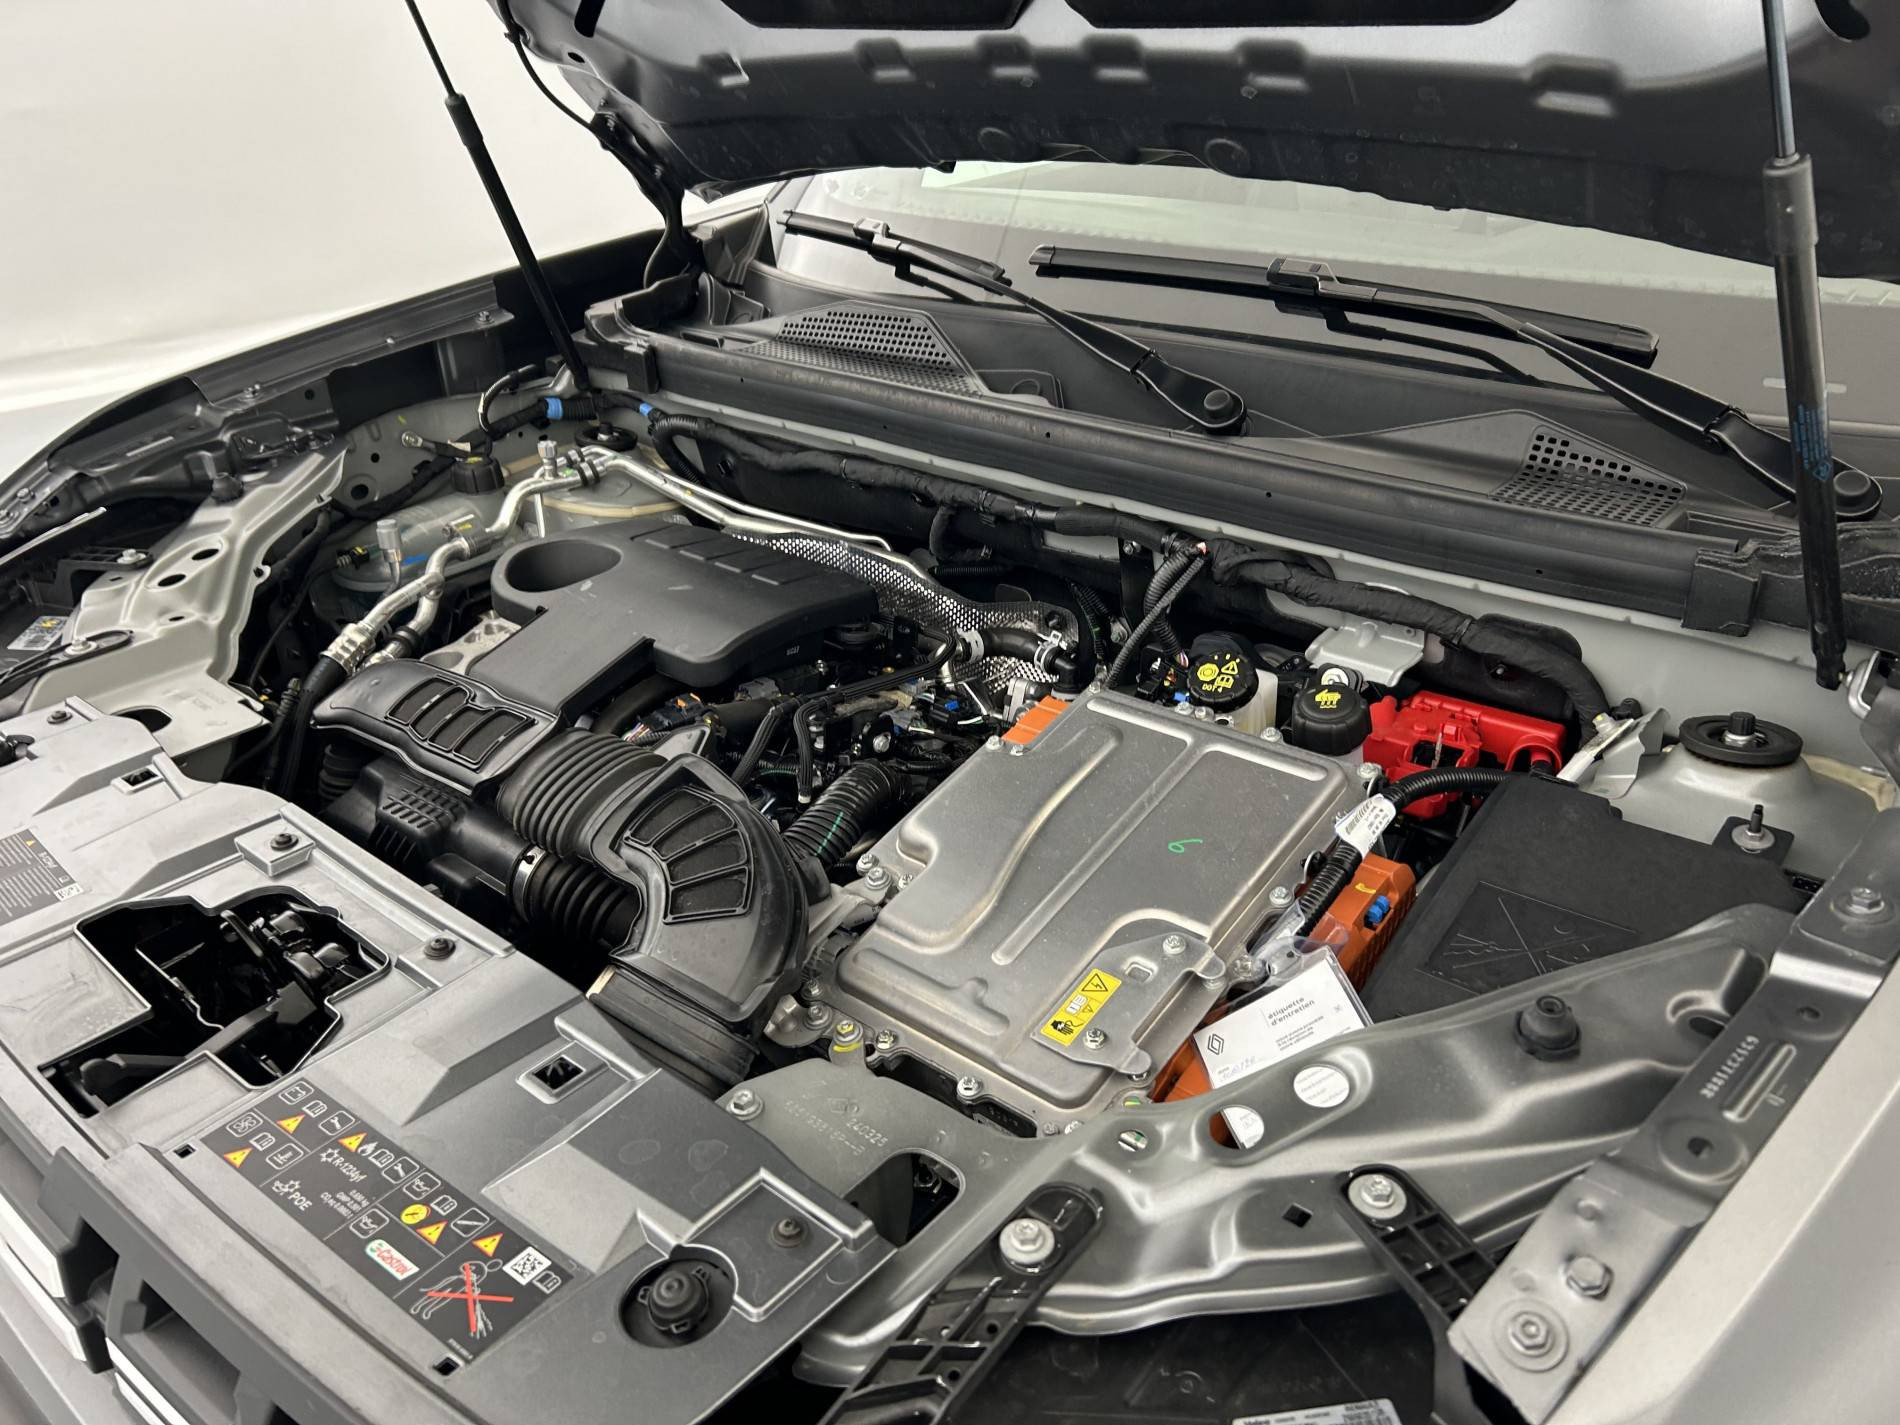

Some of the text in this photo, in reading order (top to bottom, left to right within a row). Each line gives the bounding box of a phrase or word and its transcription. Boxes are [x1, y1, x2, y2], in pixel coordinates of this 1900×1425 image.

[1270, 999, 1315, 1027] d'entretien
[846, 1117, 889, 1148] 240325
[289, 1191, 313, 1211] POE
[377, 1247, 415, 1276] Castrol
